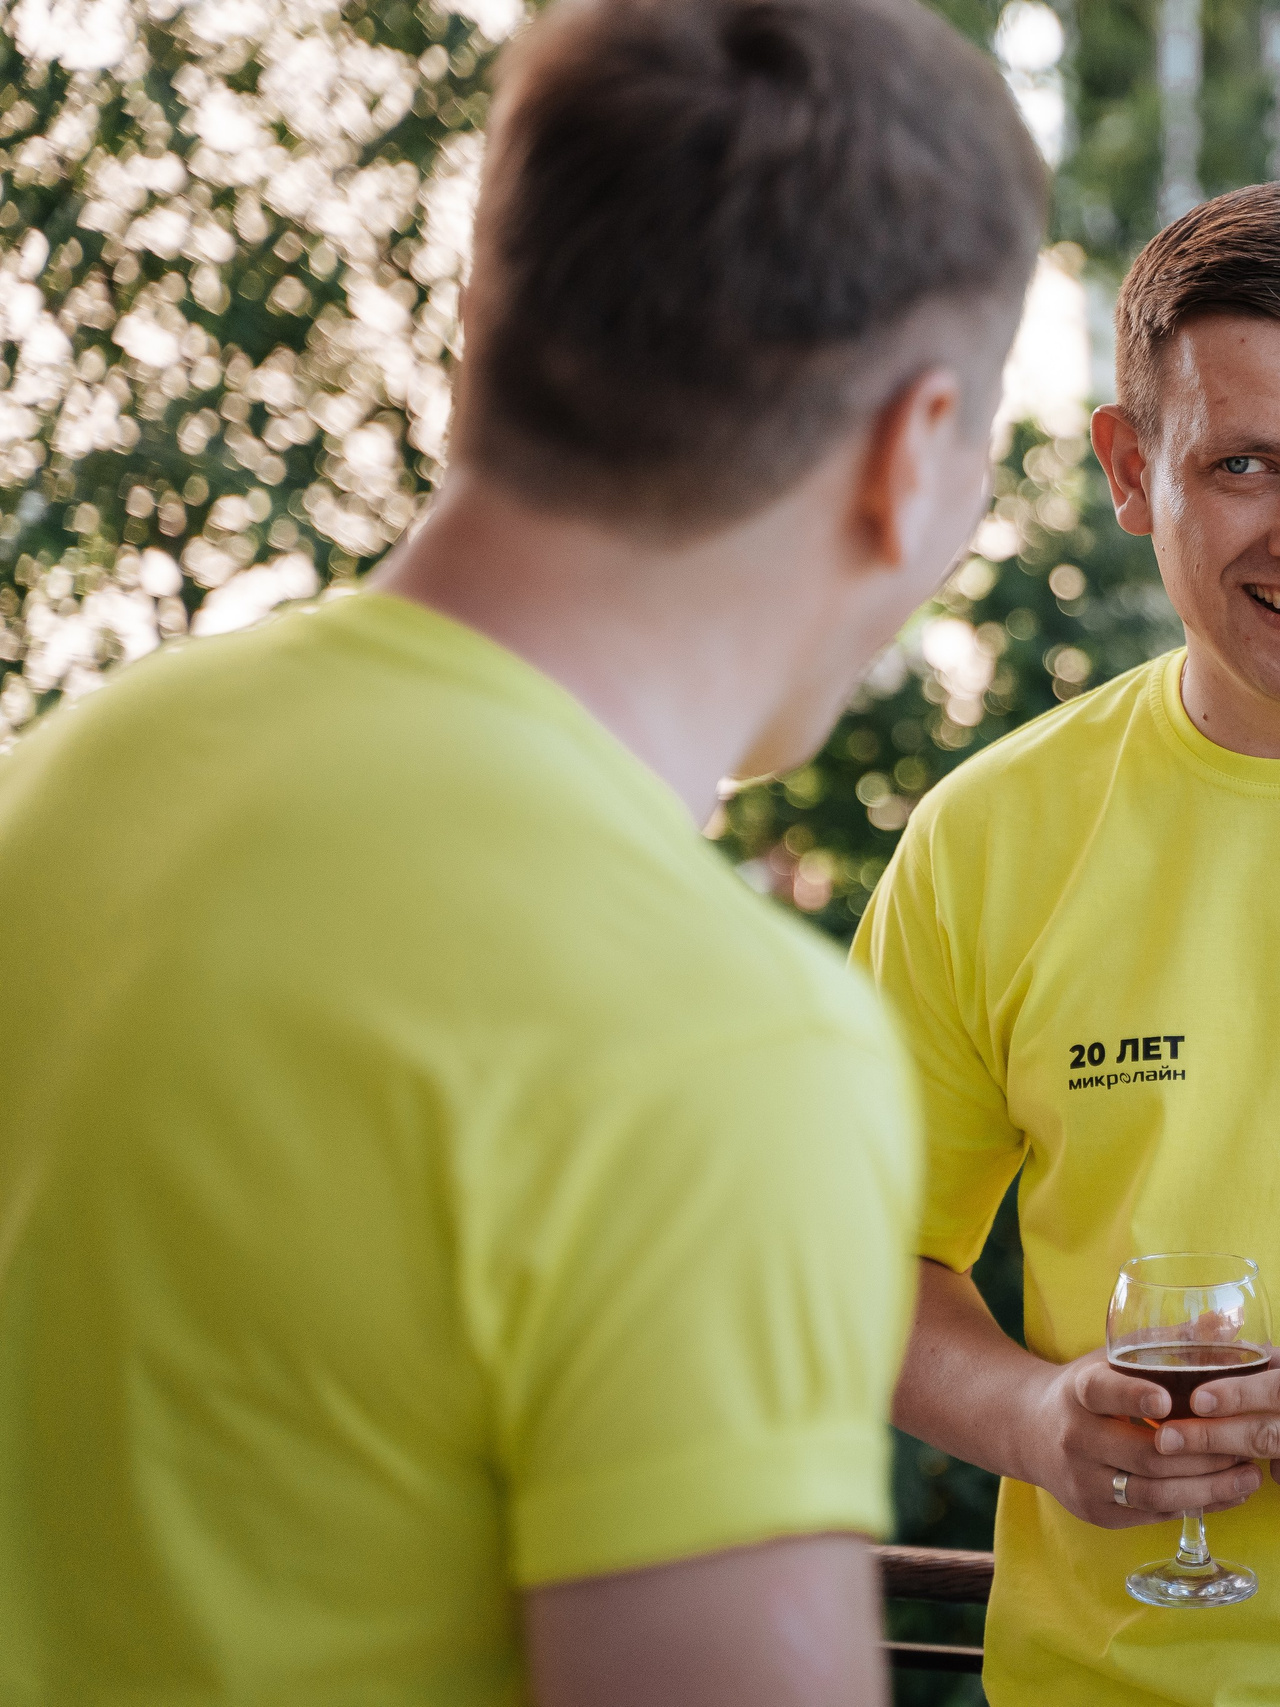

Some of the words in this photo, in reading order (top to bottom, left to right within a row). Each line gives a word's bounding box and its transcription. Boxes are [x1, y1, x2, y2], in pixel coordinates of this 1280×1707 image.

[1069, 1041, 1106, 1069] 20
[1116, 1036, 1185, 1064] ЛЕТ
[1068, 1065, 1186, 1090] микролайн
